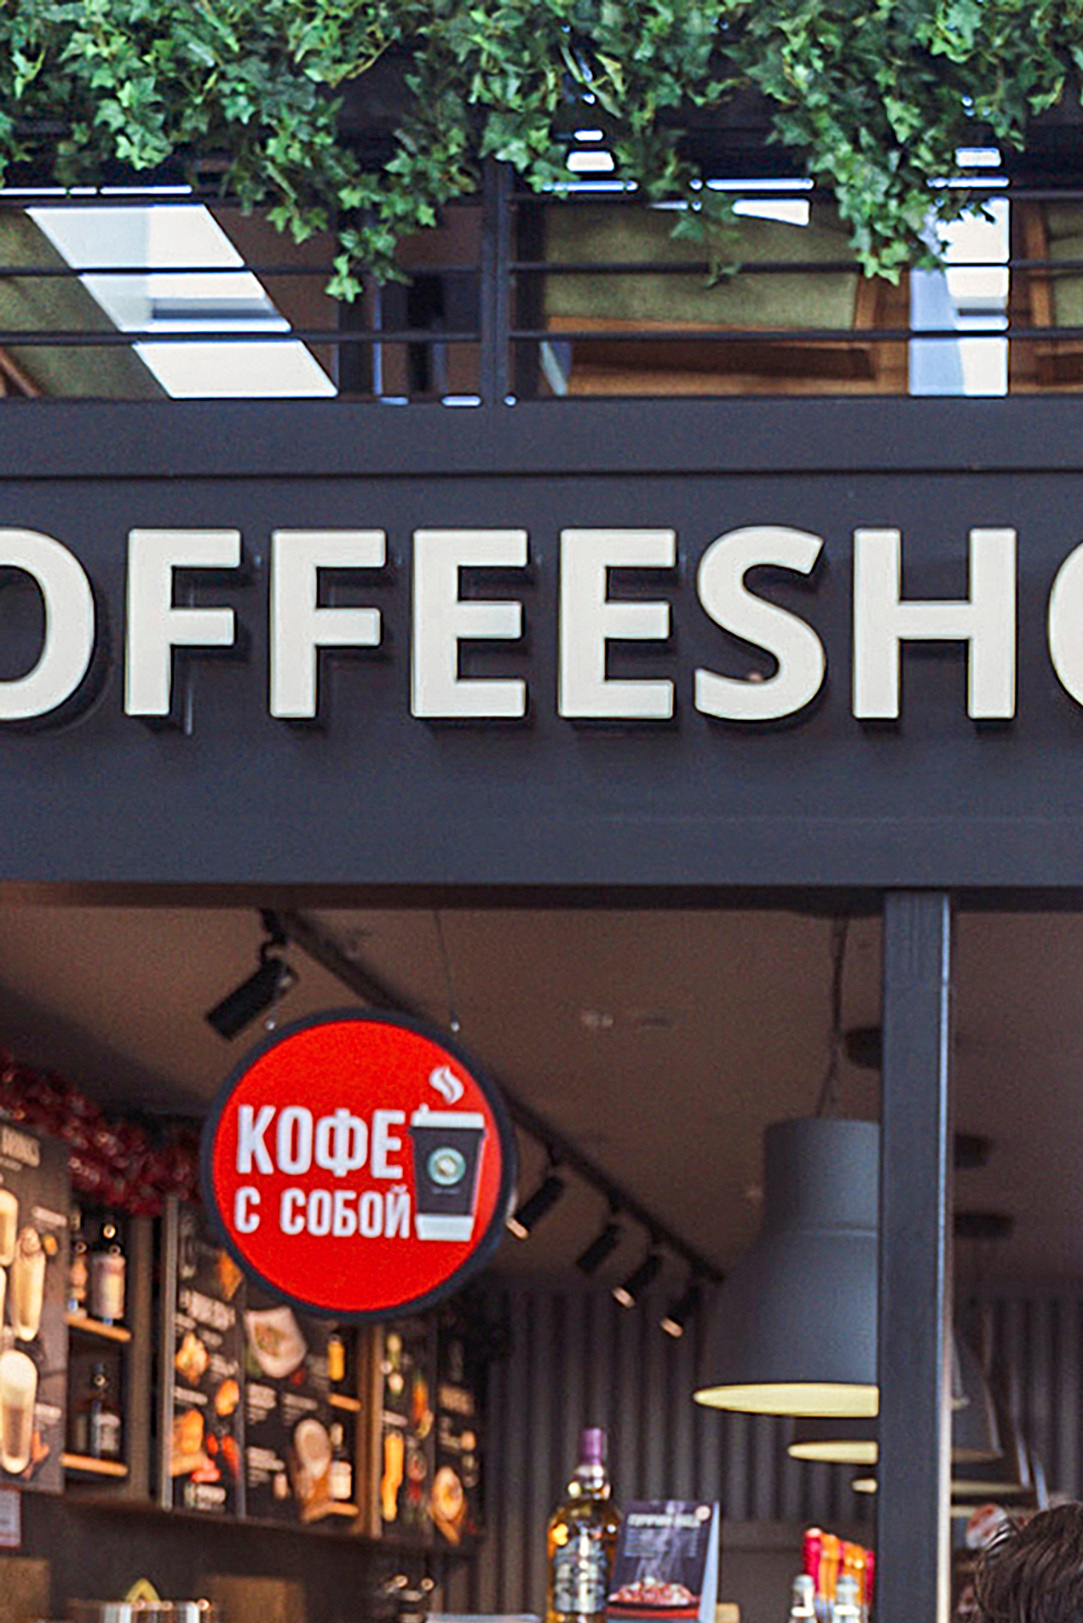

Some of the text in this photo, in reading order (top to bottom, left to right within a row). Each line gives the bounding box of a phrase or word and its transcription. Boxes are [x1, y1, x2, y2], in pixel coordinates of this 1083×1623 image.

[236, 1104, 406, 1179] КОФЕ
[234, 1184, 411, 1239] С СОБОЙ
